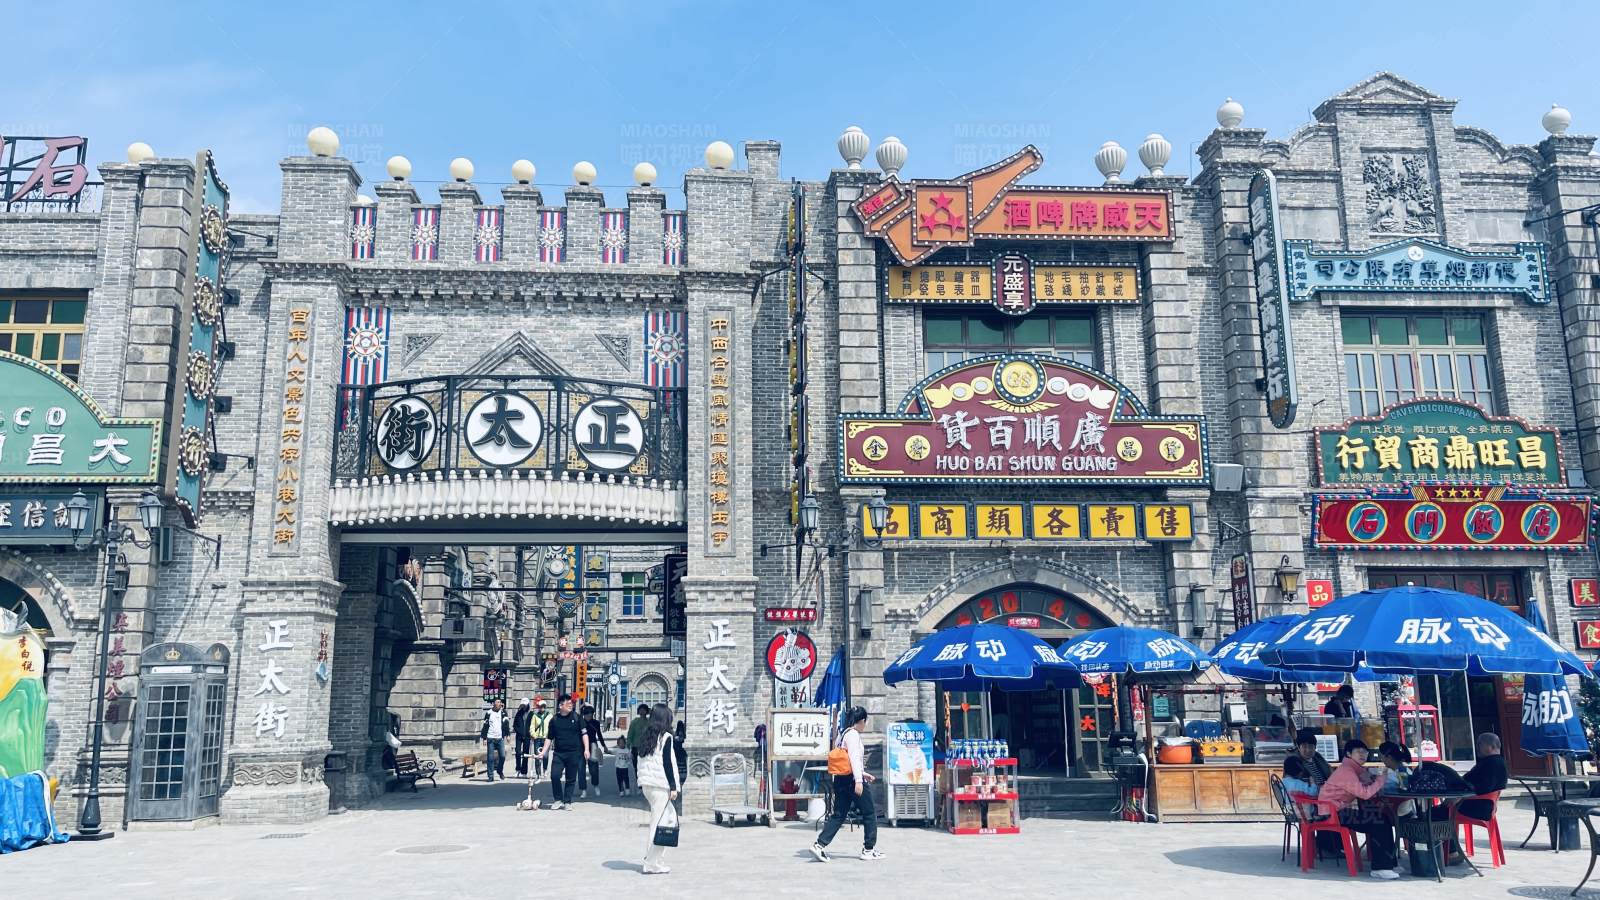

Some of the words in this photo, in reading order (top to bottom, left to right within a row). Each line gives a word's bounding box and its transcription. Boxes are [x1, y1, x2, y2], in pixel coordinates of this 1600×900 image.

[379, 395, 640, 462] 正太街
[936, 411, 1109, 454] 廣順百貨
[0, 431, 133, 467] 大昌
[936, 455, 970, 471] HUO
[1010, 455, 1056, 471] SHUN
[1061, 455, 1119, 472] GUANG
[1336, 435, 1548, 470] 昌旺鼎商貿行
[1353, 506, 1555, 540] 石門飯店
[1311, 585, 1328, 602] 品
[1395, 617, 1511, 652] 脉动
[252, 620, 294, 738] 正太街
[703, 619, 738, 734] 正太街
[780, 722, 825, 738] 便利店
